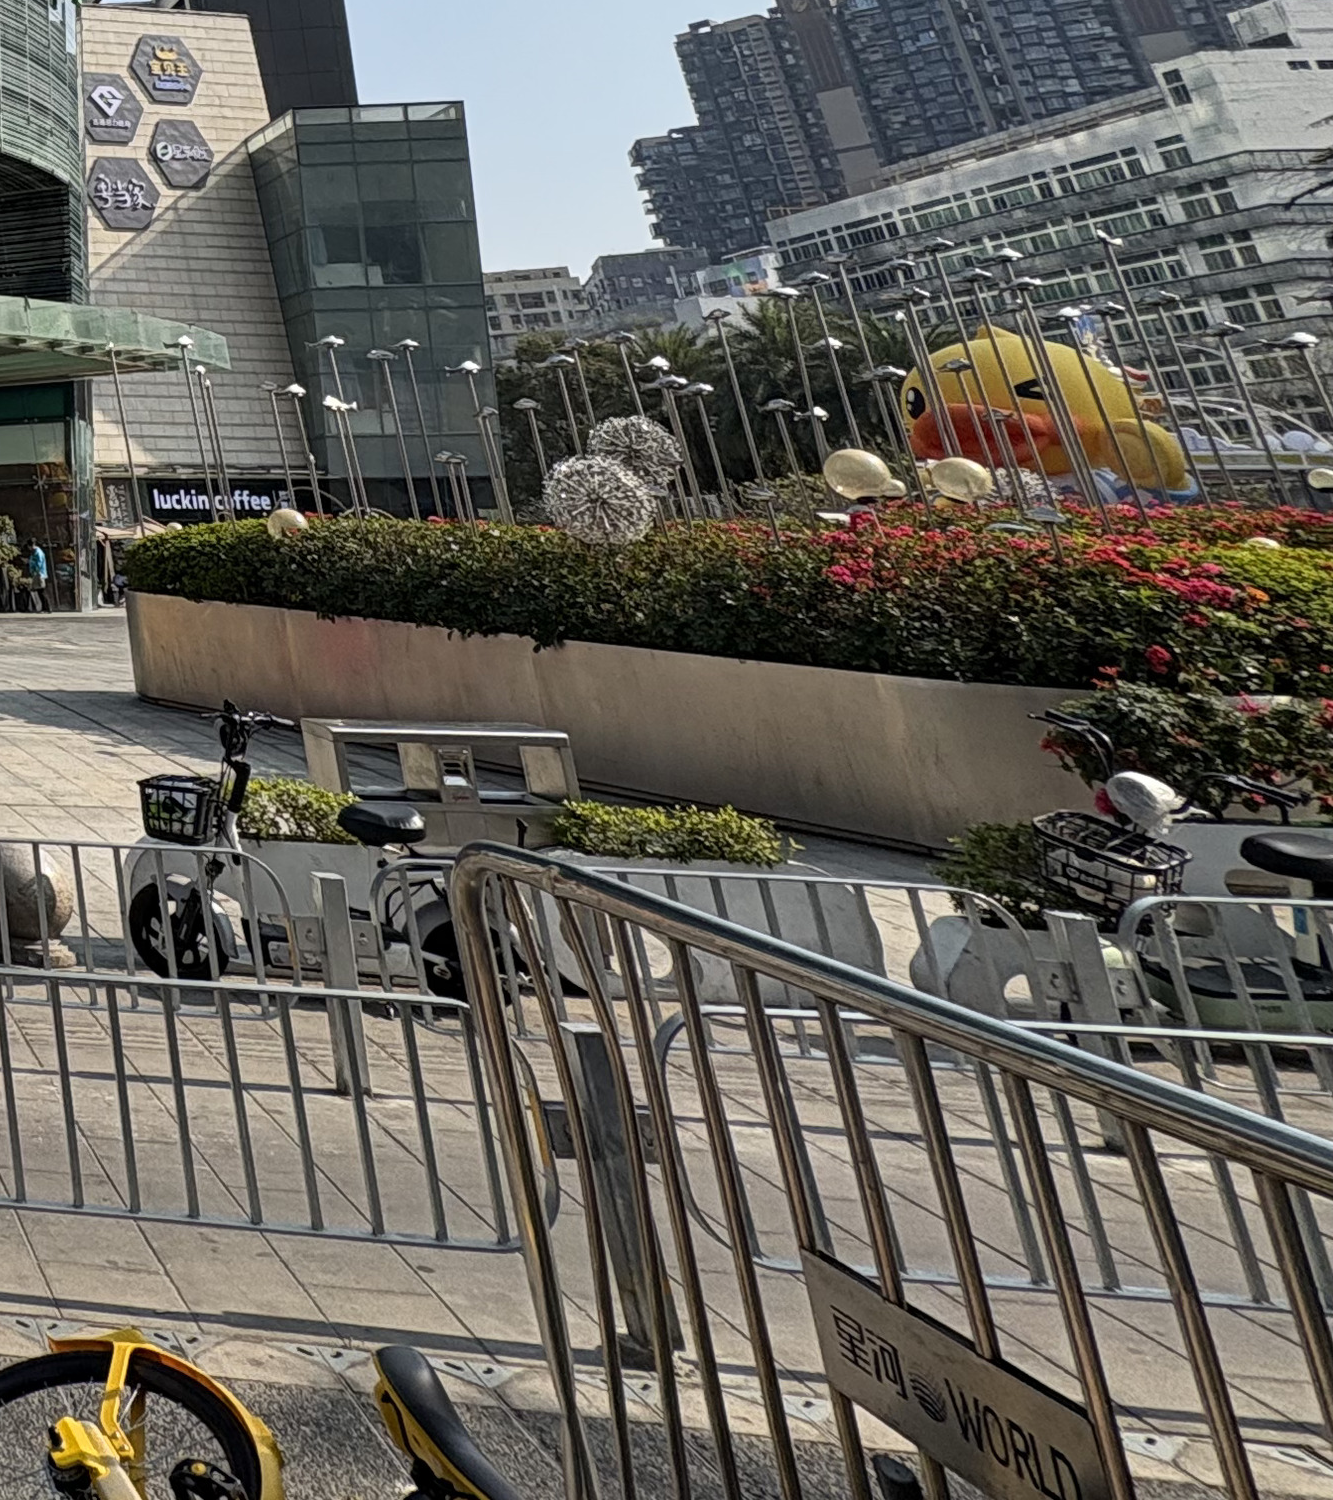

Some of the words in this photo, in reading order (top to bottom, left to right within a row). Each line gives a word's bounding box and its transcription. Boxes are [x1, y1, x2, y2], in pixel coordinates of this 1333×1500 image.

[153, 488, 210, 510] luckin
[830, 1304, 909, 1401] 星河
[944, 1378, 1084, 1500] WORLD
